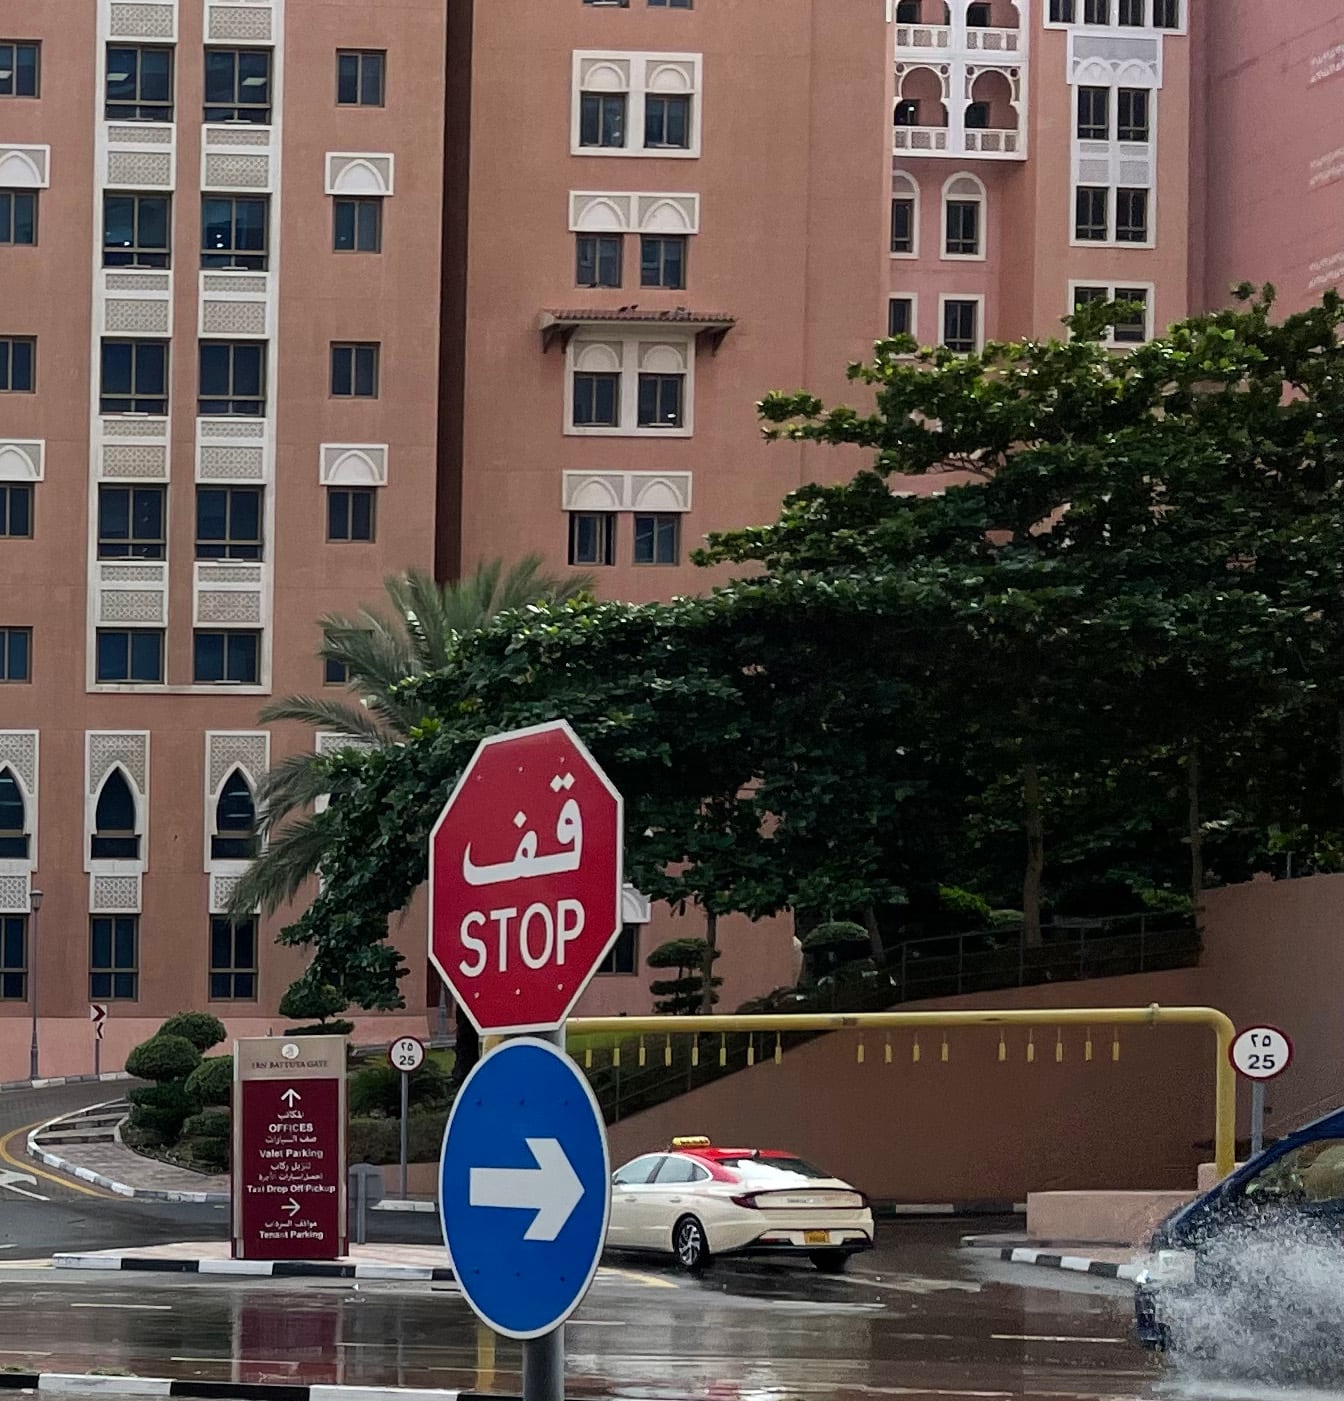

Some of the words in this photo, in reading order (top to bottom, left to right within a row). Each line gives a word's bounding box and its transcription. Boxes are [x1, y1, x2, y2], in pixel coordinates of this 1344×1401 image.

[463, 771, 585, 886] قف
[459, 898, 586, 979] STOP
[1250, 1033, 1272, 1048] ٢٥
[399, 1055, 416, 1066] 25
[1247, 1053, 1276, 1070] 25
[268, 1122, 314, 1133] OFFICES
[259, 1149, 284, 1158] Valet
[285, 1149, 324, 1159] Parking
[266, 1184, 289, 1194] Drop
[259, 1230, 289, 1239] Tenant
[290, 1230, 324, 1240] Parking
